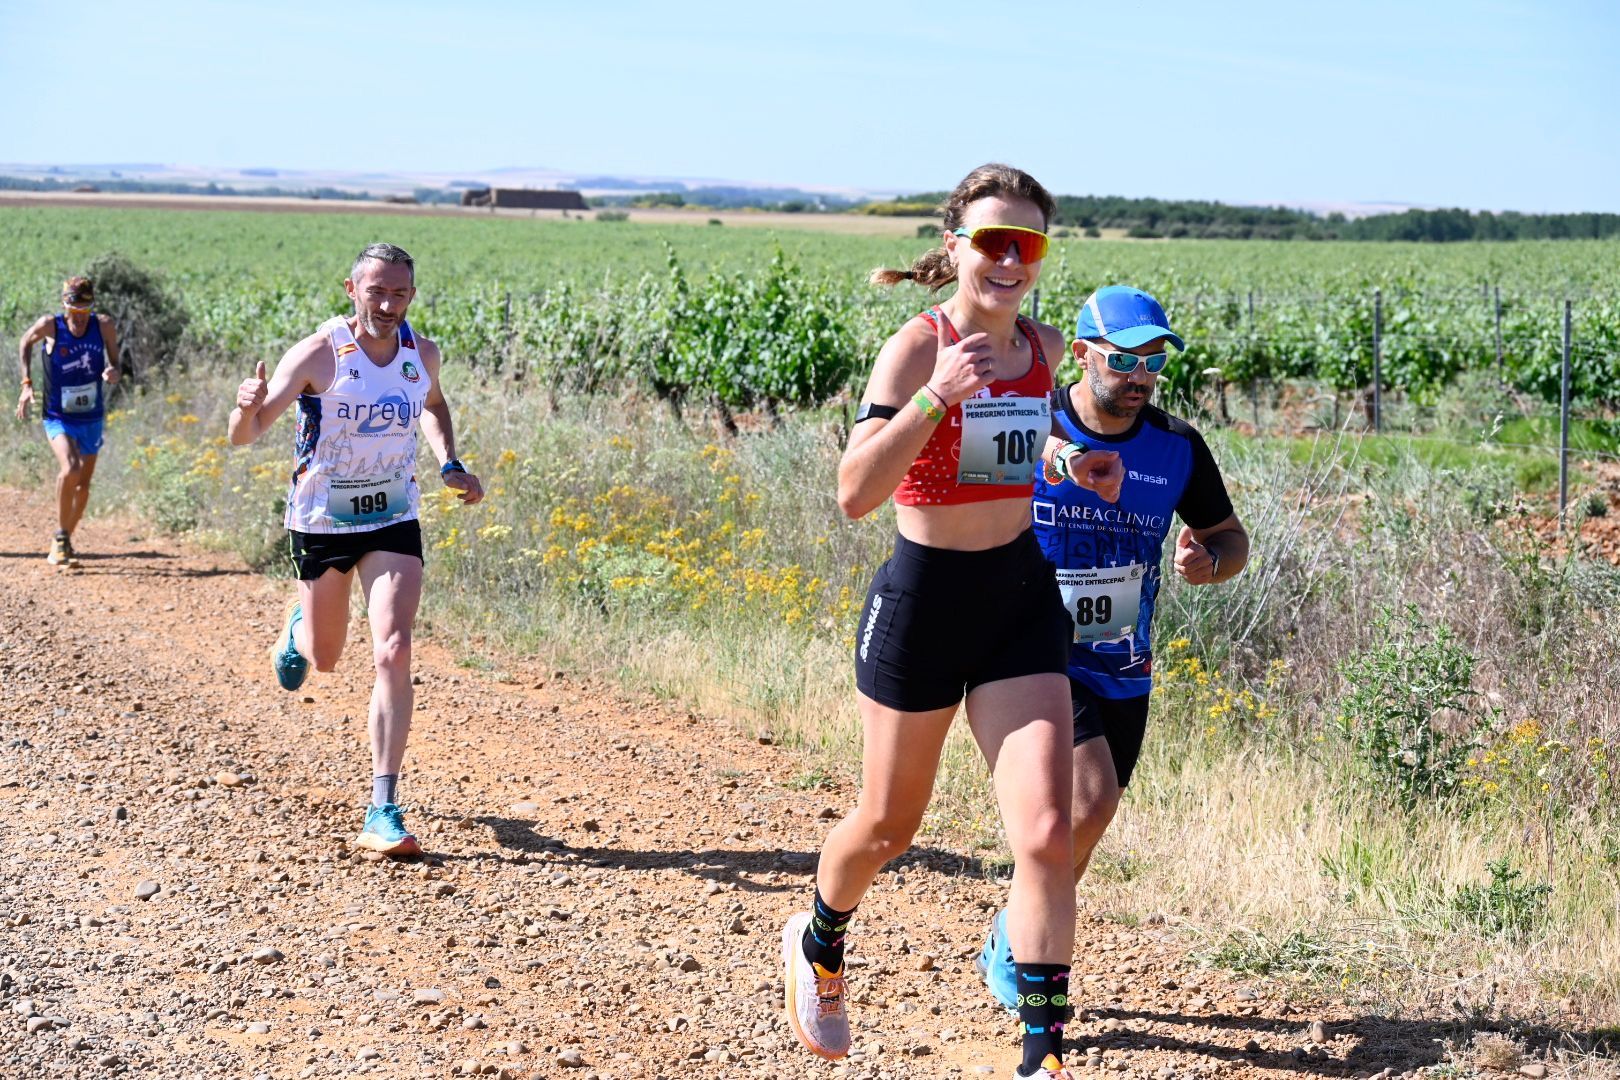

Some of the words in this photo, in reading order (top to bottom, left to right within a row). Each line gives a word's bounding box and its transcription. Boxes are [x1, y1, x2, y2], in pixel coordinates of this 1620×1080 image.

[76, 395, 88, 405] 49
[965, 410, 1006, 419] PEREGRINO
[1006, 409, 1039, 417] ENTRECEPAS
[992, 428, 1037, 465] 108
[349, 491, 388, 516] 199
[1085, 577, 1125, 586] ENTRECEPAS
[1076, 595, 1112, 627] 89
